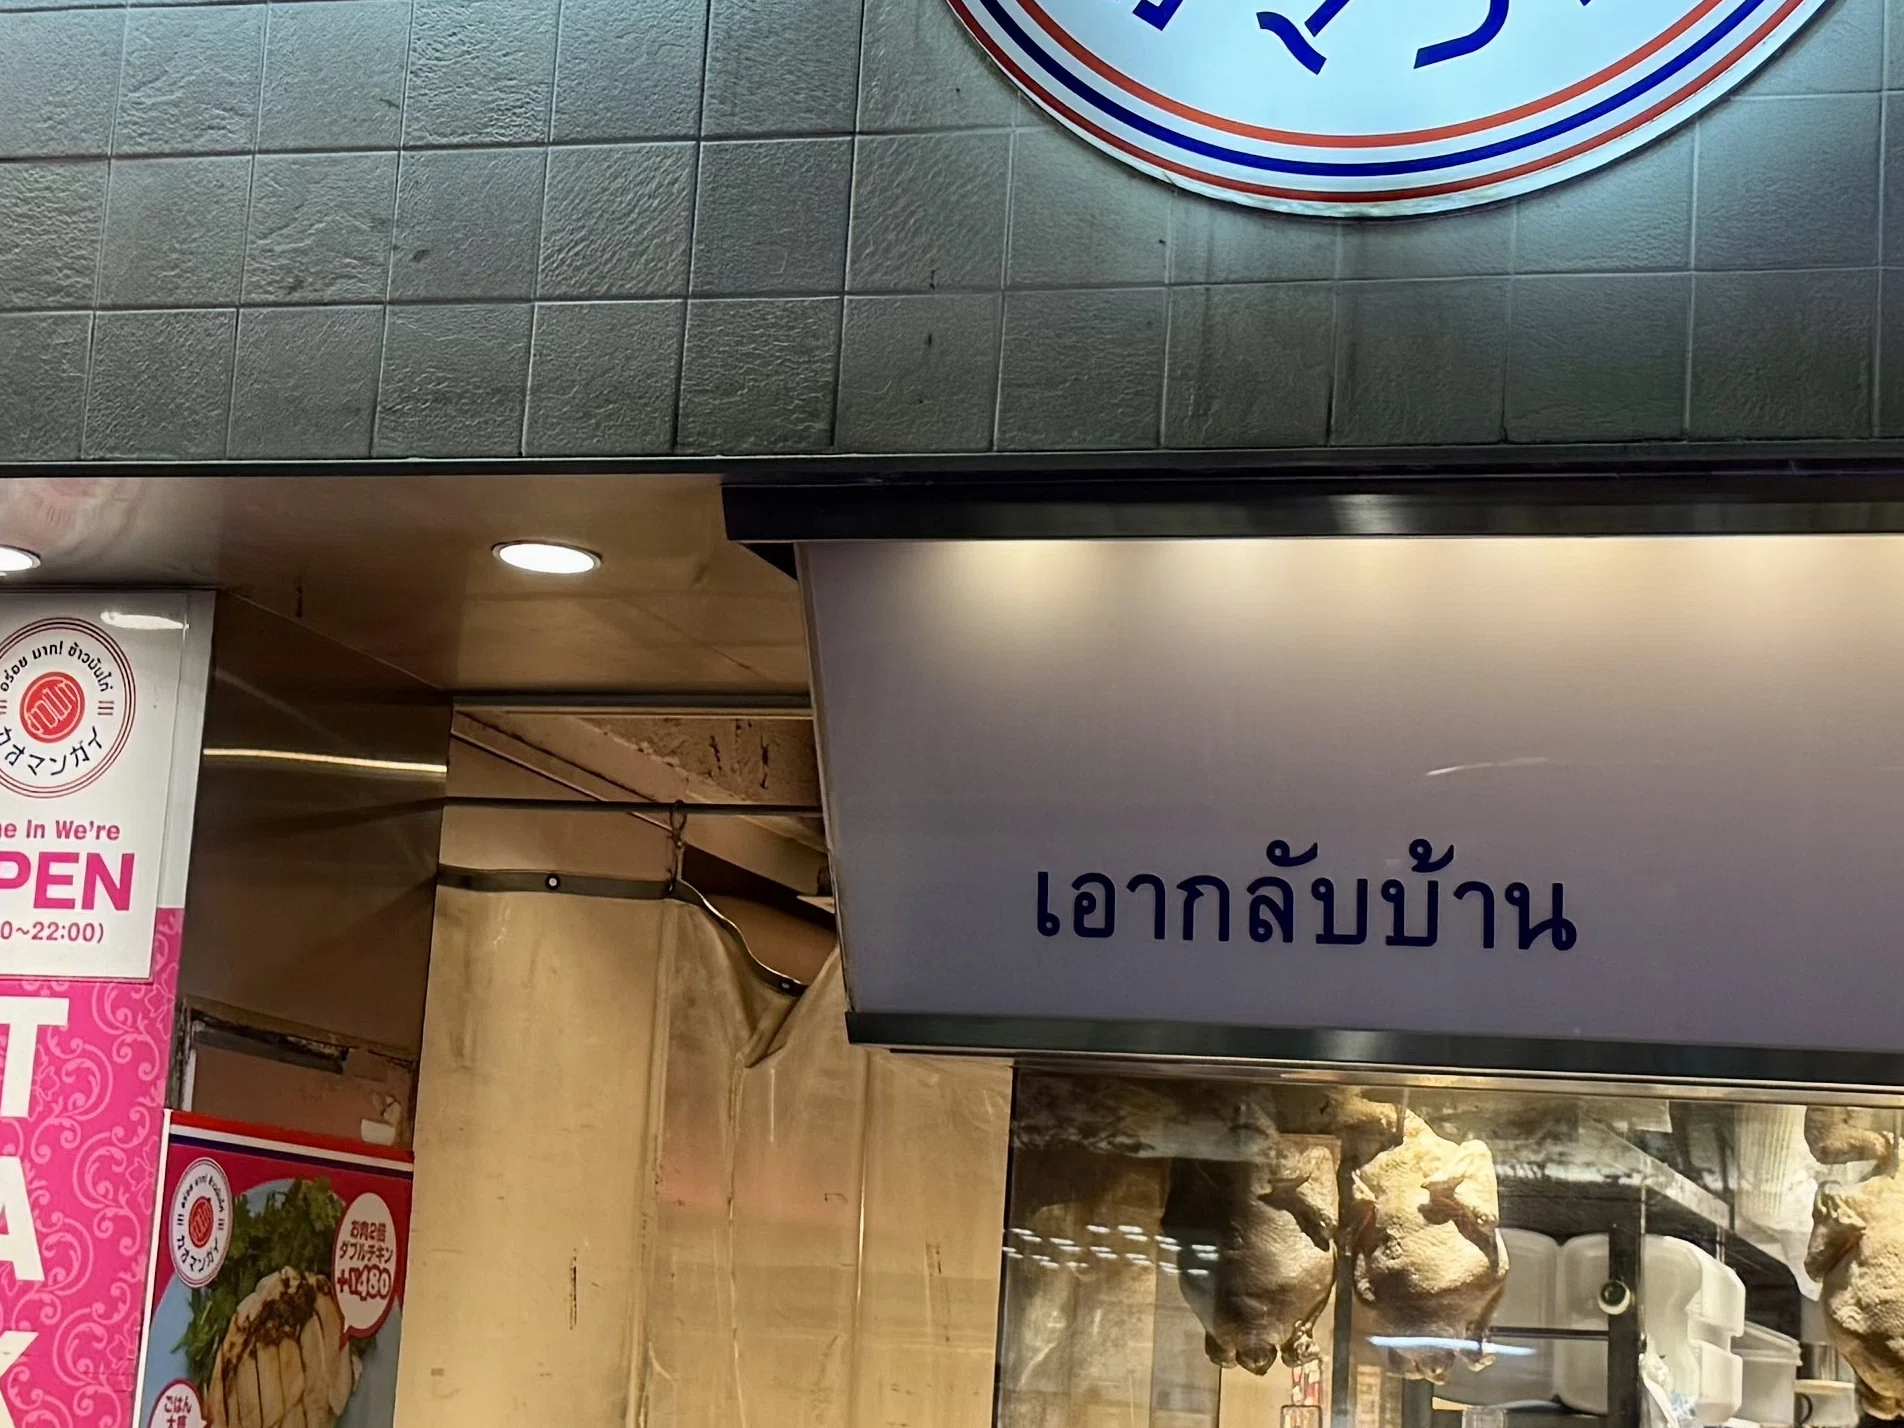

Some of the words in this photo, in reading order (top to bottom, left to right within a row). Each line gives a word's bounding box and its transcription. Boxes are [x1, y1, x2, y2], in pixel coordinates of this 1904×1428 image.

[25, 819, 46, 839] In
[54, 820, 121, 841] We're
[1033, 835, 1578, 954] เอากลับบ้าน
[338, 1239, 394, 1264] ダブルチキン
[163, 1395, 193, 1415] ごはん
